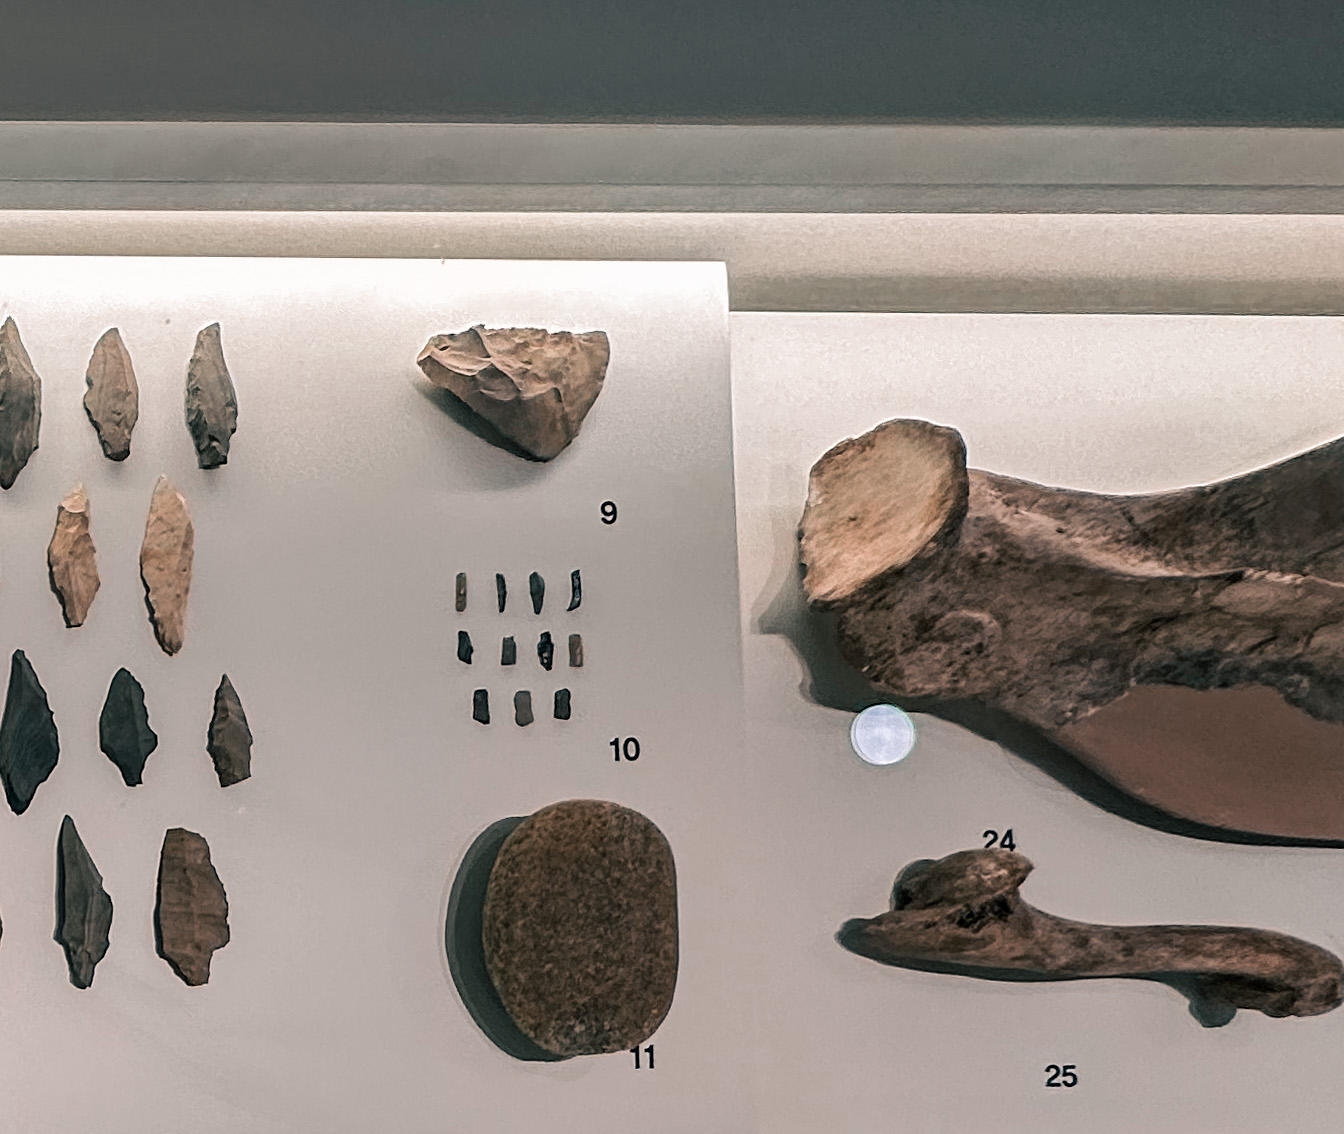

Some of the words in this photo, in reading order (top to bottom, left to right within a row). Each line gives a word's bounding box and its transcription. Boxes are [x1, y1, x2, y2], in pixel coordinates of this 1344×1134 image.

[600, 500, 618, 525] 9
[609, 736, 641, 762] 10
[982, 829, 1017, 853] 24
[631, 1044, 656, 1069] 11
[1044, 1064, 1078, 1088] 25
